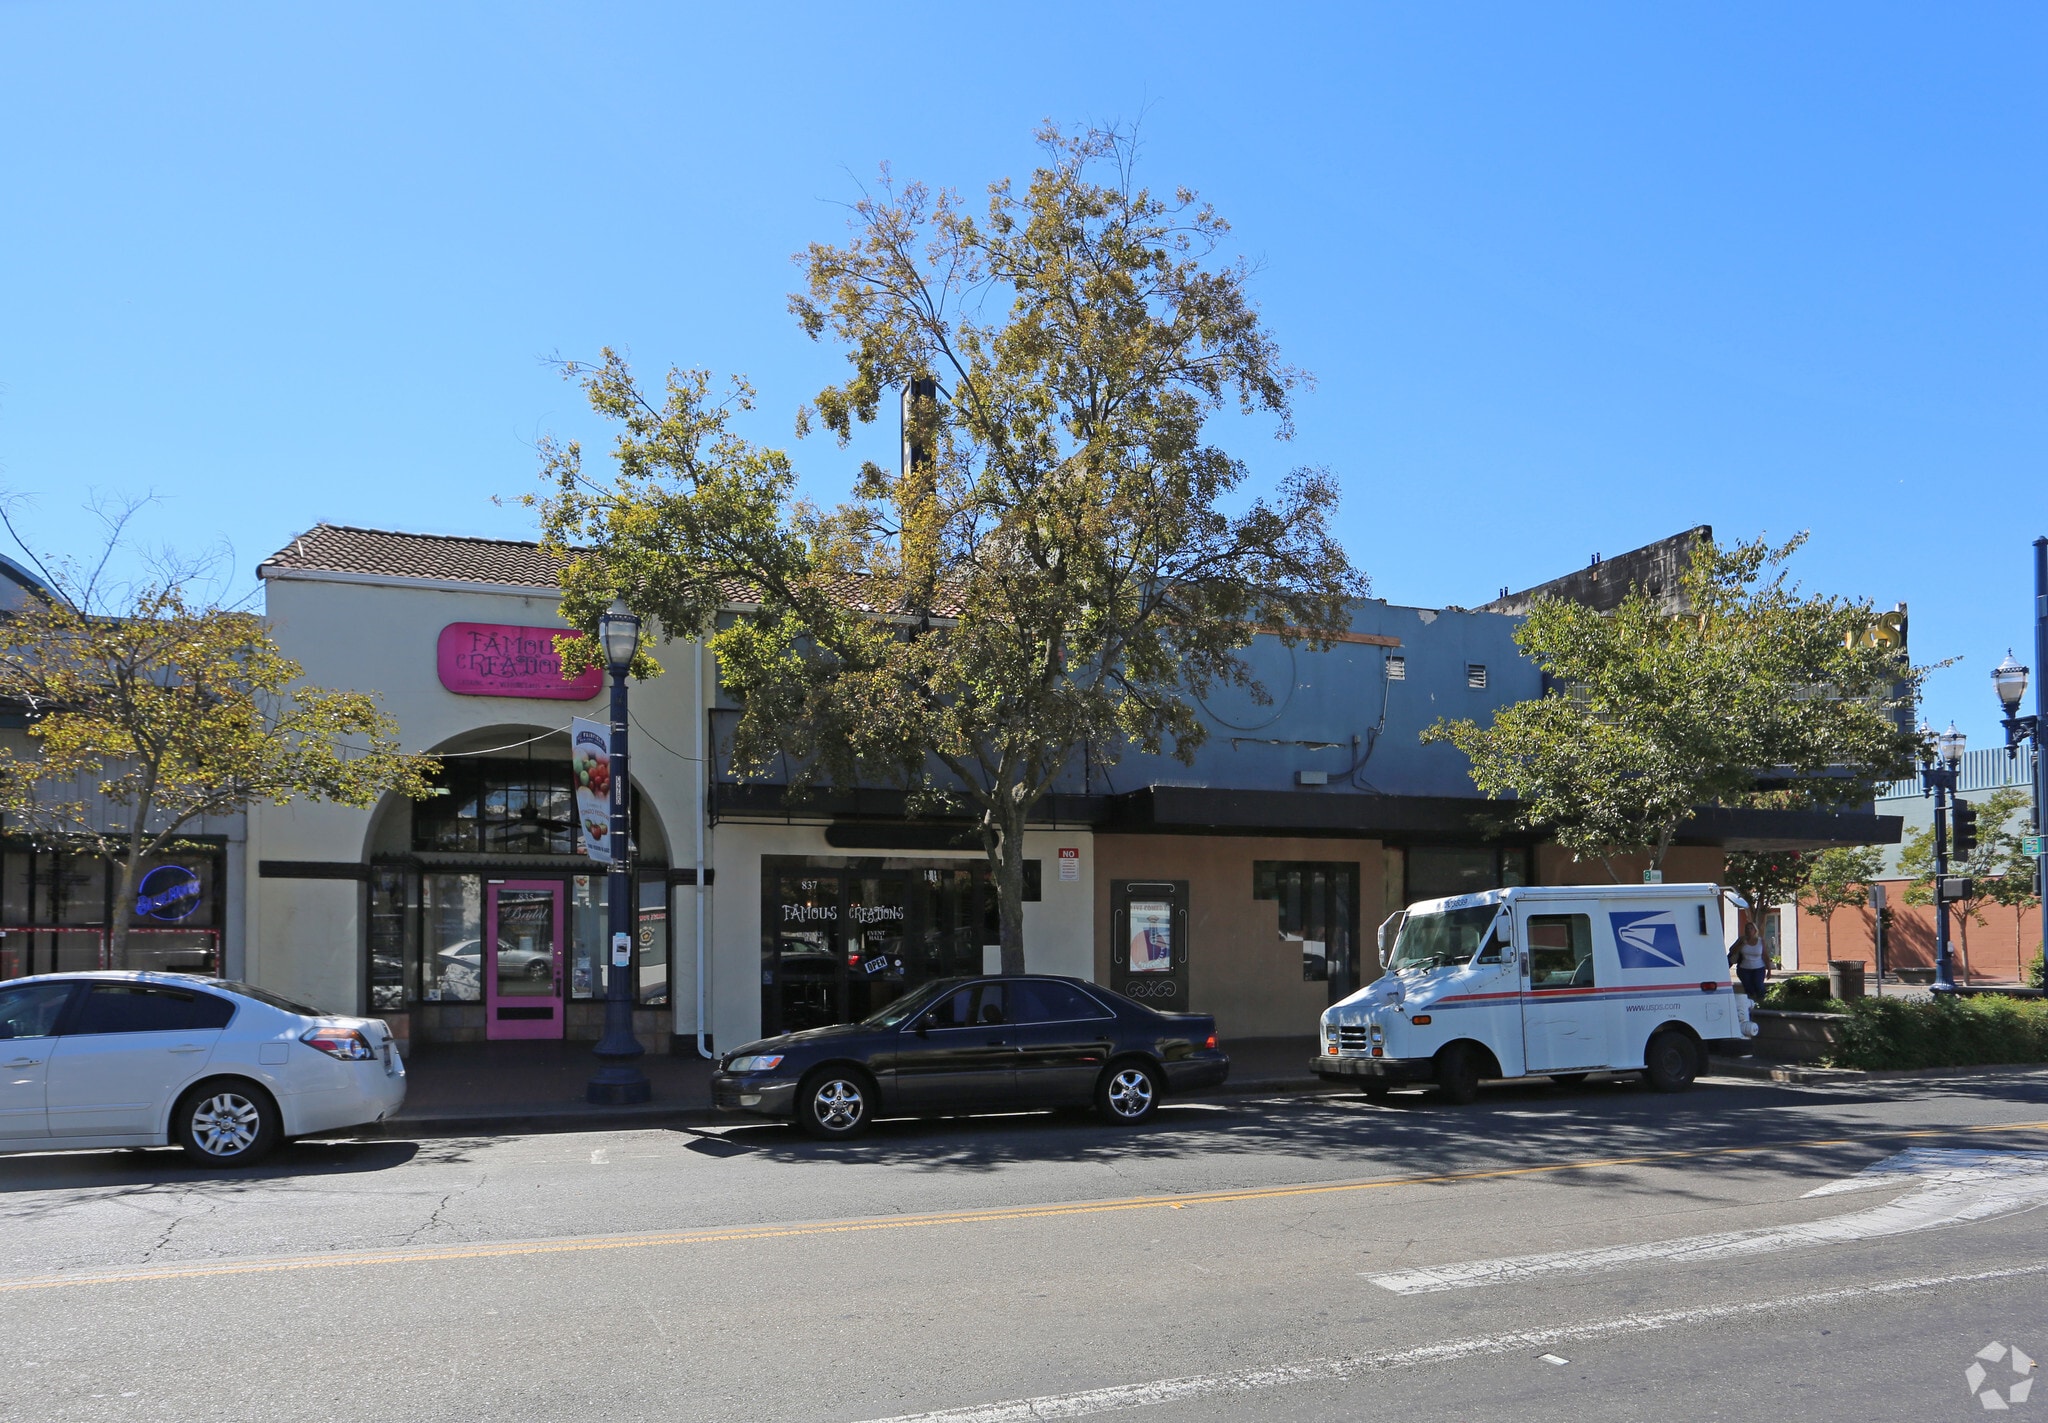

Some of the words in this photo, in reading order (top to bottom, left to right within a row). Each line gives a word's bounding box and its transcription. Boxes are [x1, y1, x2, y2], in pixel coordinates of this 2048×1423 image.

[468, 632, 553, 656] FAMOU
[456, 654, 568, 678] CREATION
[1062, 850, 1075, 858] NO
[1645, 872, 1650, 880] 2
[801, 881, 818, 890] 837
[518, 893, 534, 901] 835
[504, 906, 548, 920] Bridal
[782, 904, 838, 923] FAMOUS
[848, 905, 904, 924] CREATIONS
[866, 957, 887, 972] OPEN
[1626, 1003, 1681, 1012] www.usps.com
